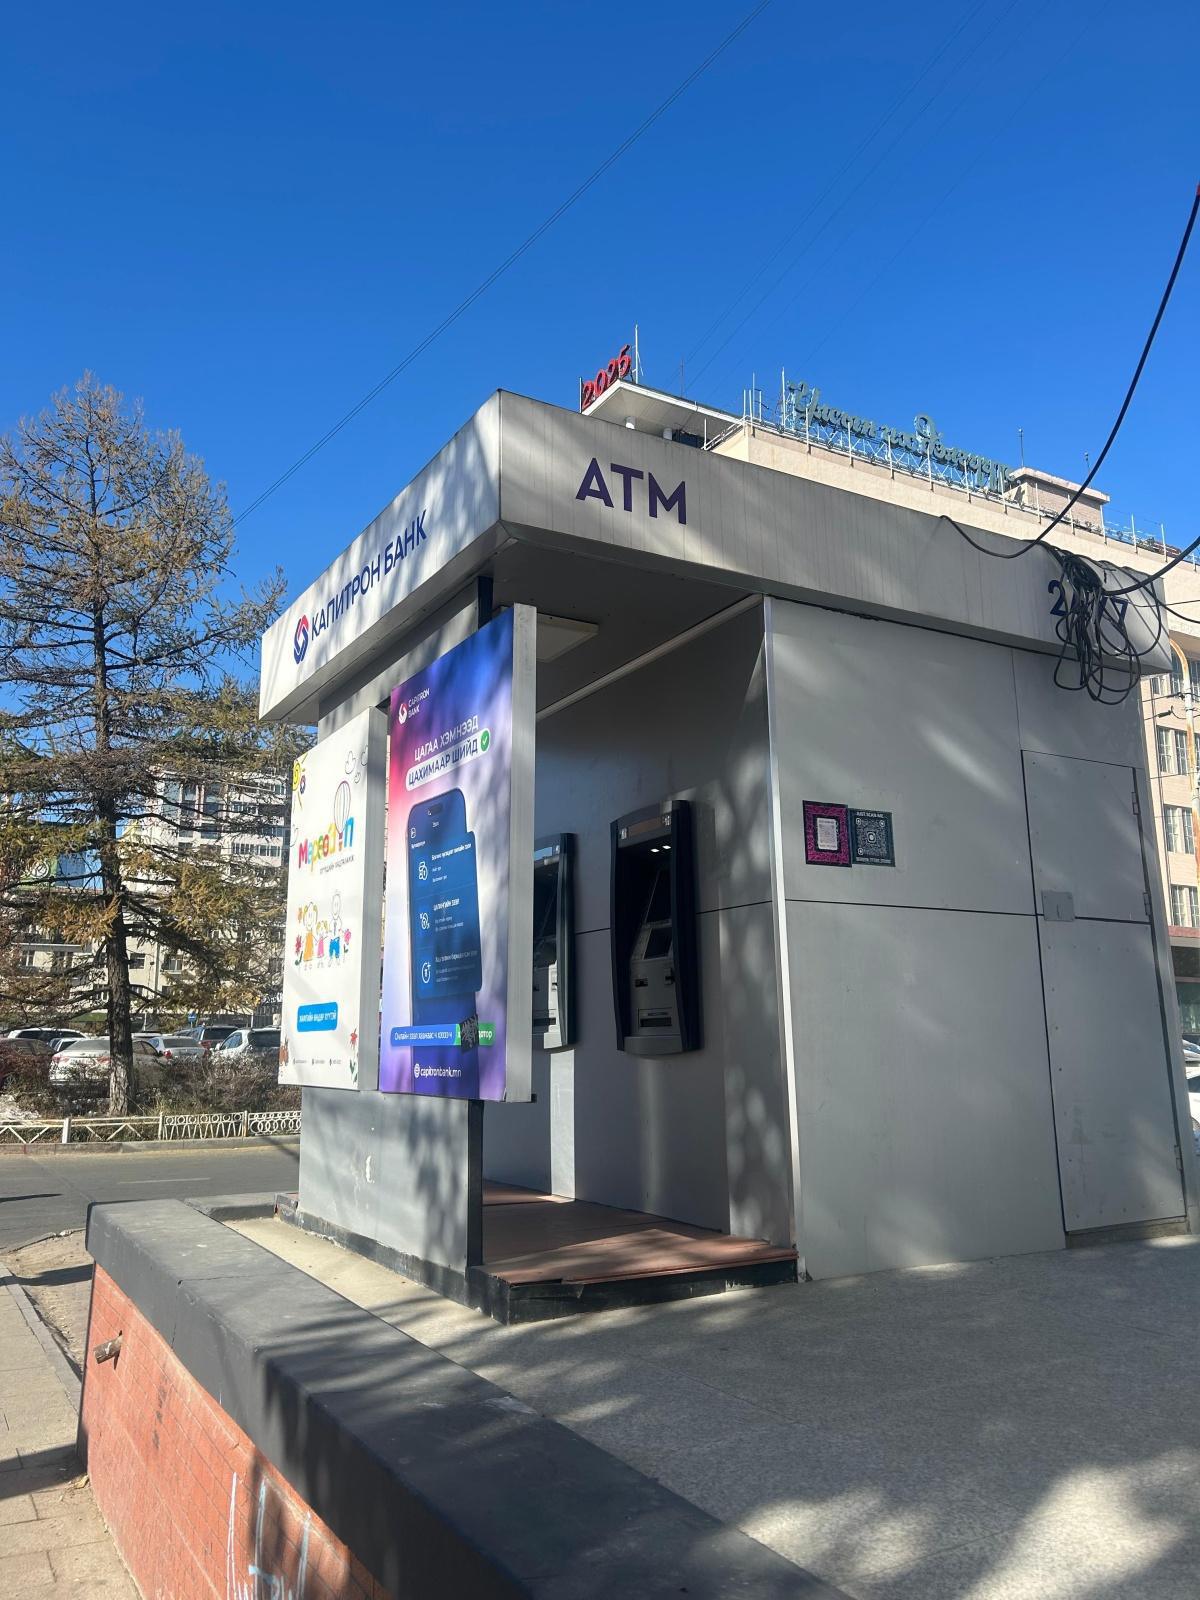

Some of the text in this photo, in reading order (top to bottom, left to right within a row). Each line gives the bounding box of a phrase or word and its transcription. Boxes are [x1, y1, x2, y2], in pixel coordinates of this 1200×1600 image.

[575, 457, 687, 526] ATM
[311, 508, 428, 641] КАПИТРОН БАНК
[408, 687, 431, 708] CAPITRON
[408, 704, 421, 719] BANK
[408, 737, 479, 787] ЦАХИМААР ШИЙД
[414, 737, 439, 762] ЦАГАА
